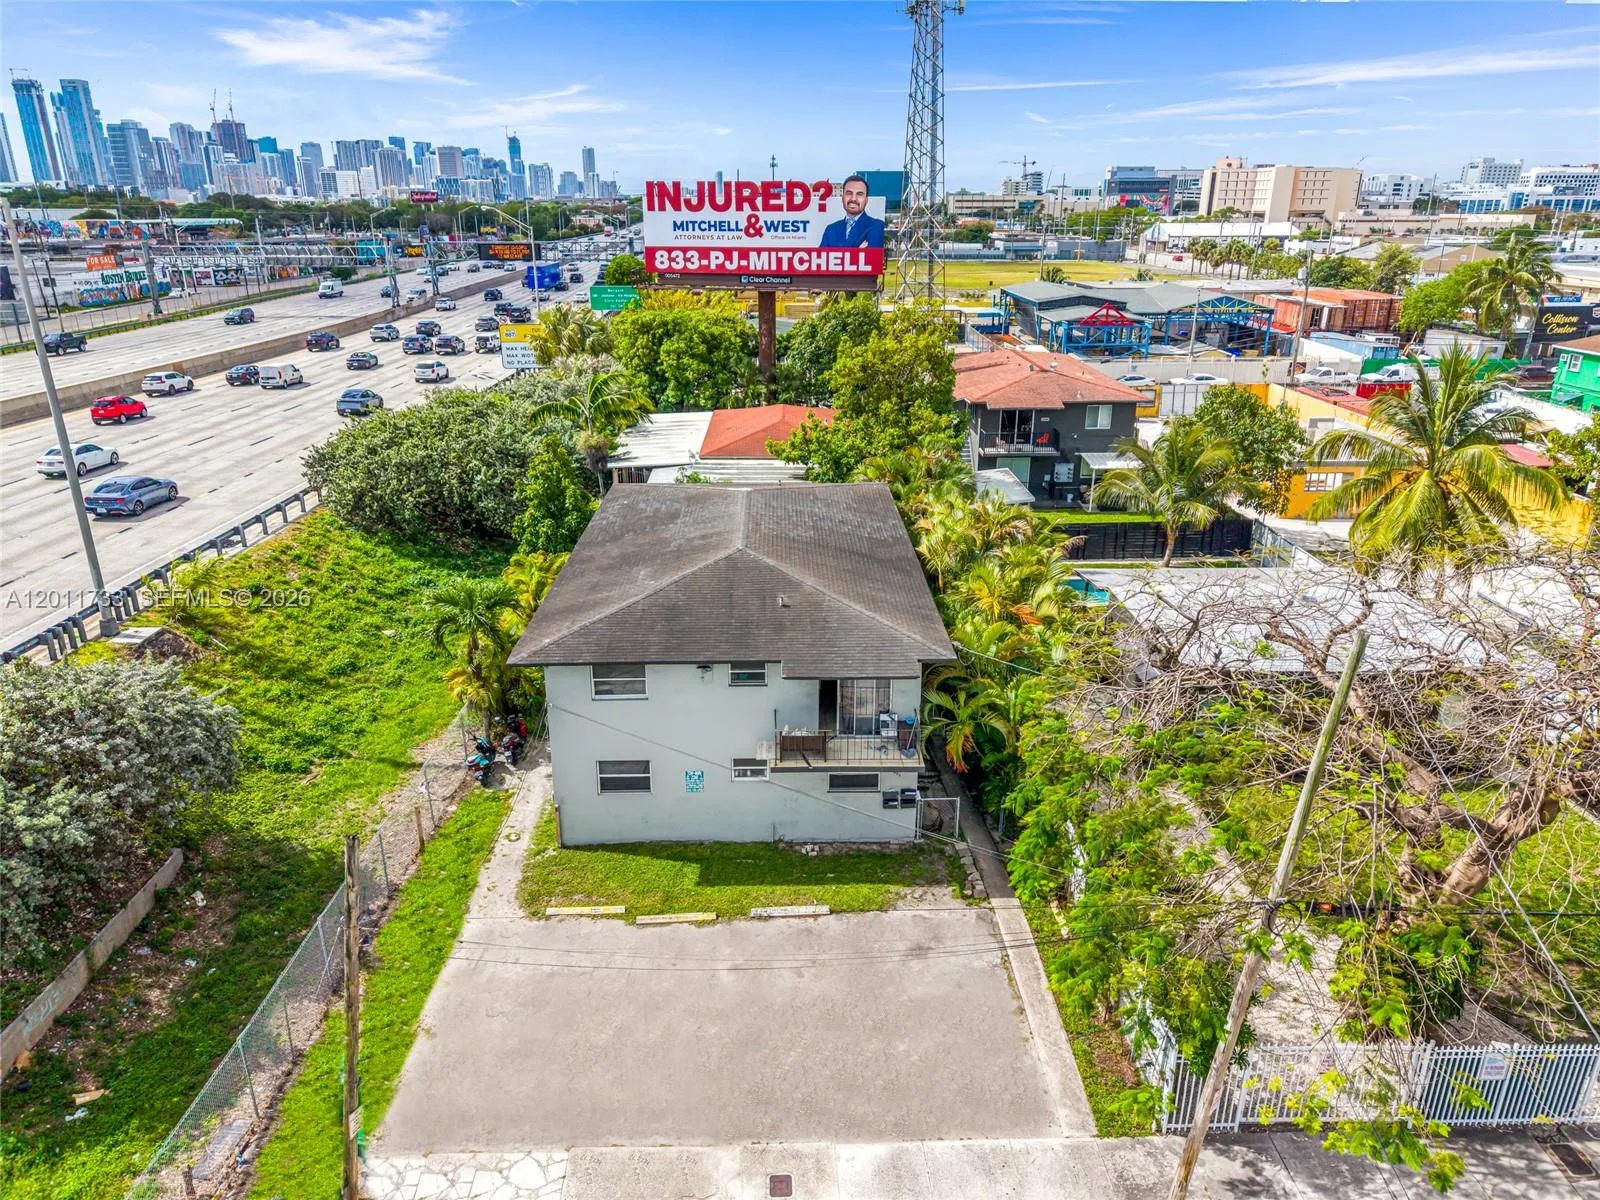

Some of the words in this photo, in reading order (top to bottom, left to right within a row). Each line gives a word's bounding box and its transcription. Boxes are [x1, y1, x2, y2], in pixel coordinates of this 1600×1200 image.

[645, 179, 833, 213] INJURED?
[672, 220, 743, 232] MITCHELL
[743, 213, 764, 239] &
[764, 220, 810, 233] WEST
[86, 257, 98, 265] FOR
[100, 255, 116, 264] SALE
[655, 250, 872, 272] 833-PJ-MITCHELL
[749, 276, 766, 284] Clear
[766, 276, 791, 284] Channel
[1542, 313, 1579, 325] Collision
[1546, 323, 1578, 335] Center
